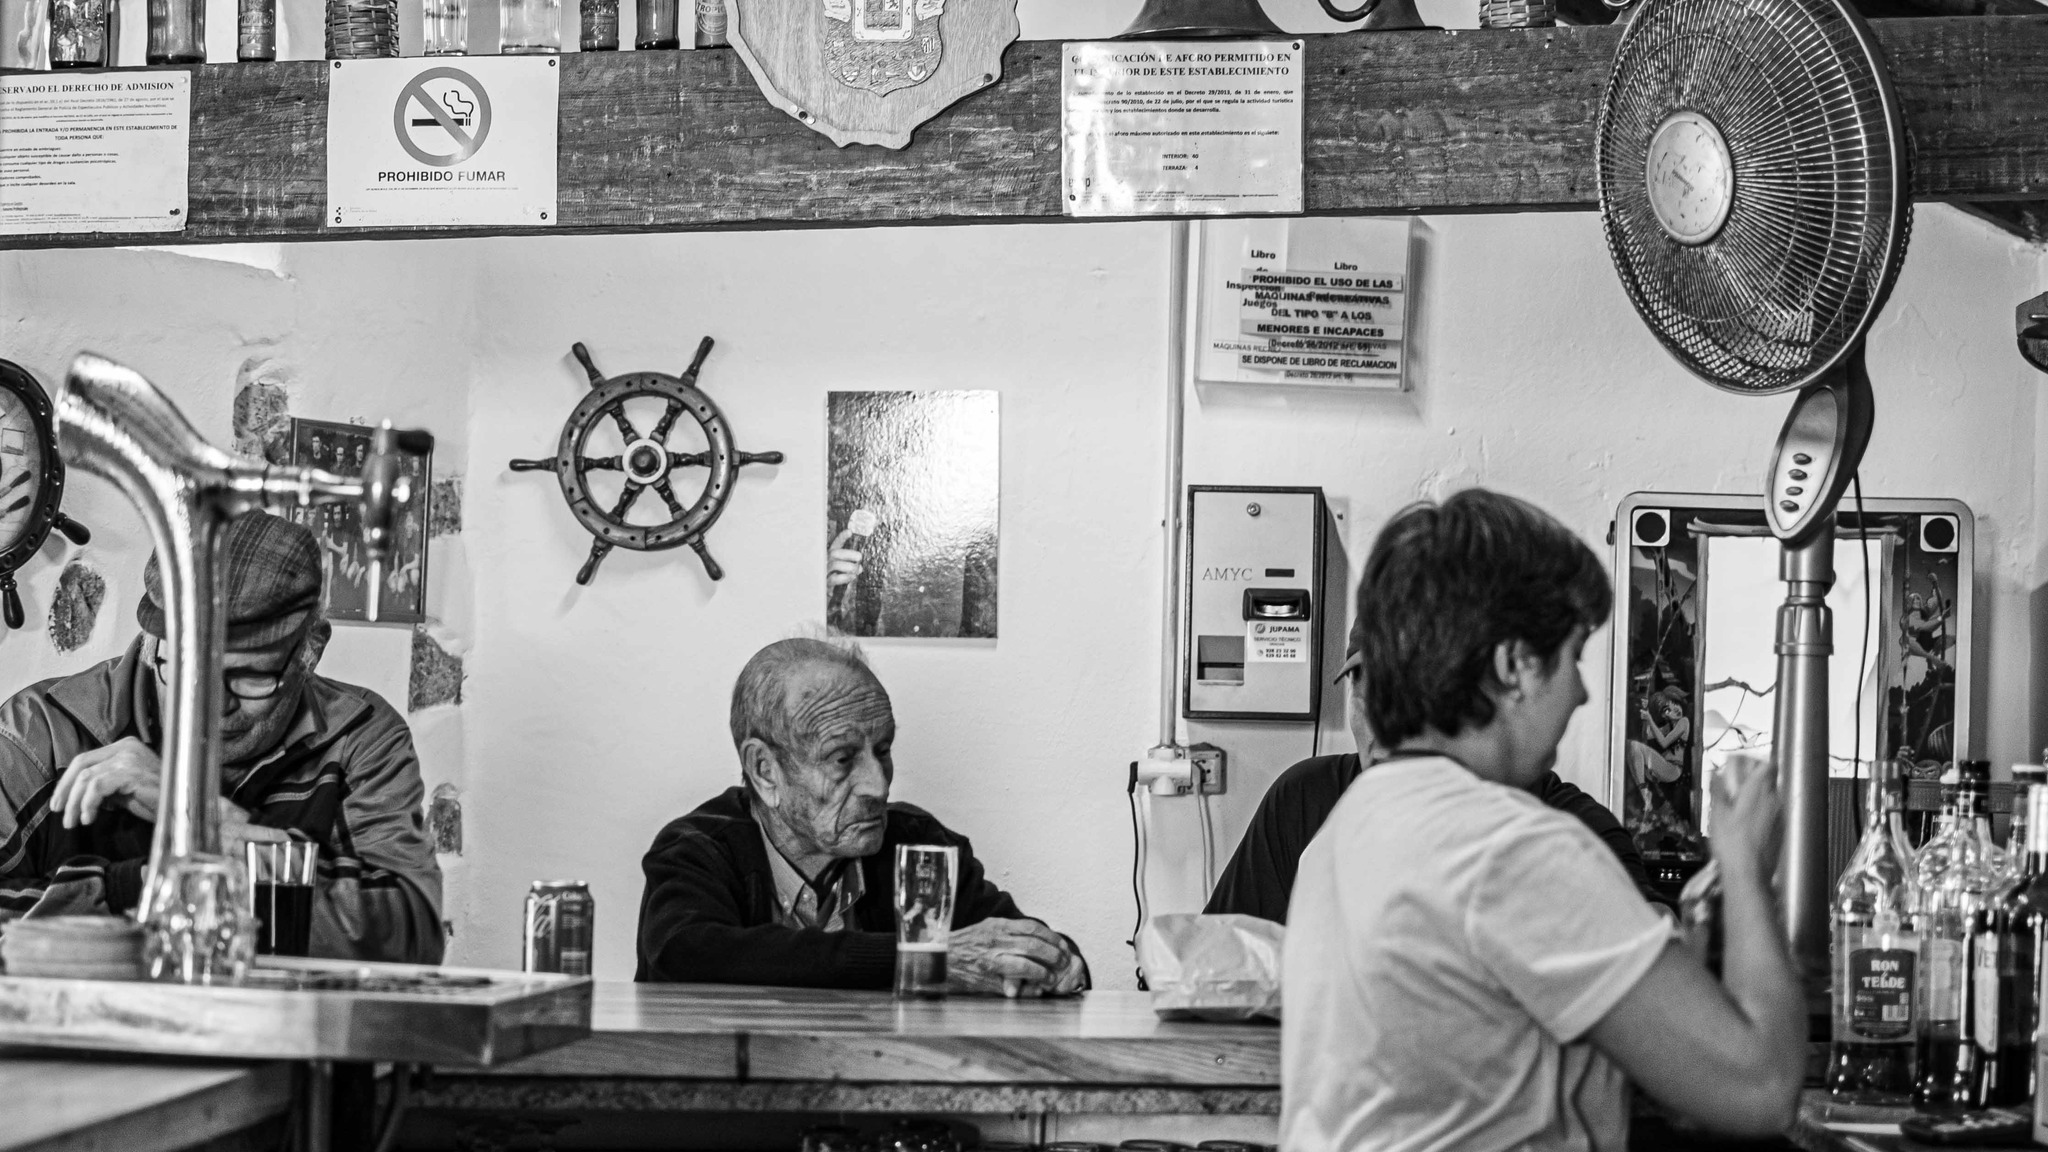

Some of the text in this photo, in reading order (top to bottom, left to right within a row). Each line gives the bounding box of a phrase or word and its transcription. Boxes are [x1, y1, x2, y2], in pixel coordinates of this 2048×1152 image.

[1174, 54, 1212, 62] AFORO
[1214, 54, 1274, 62] PERMITIDO
[1277, 54, 1291, 62] EN
[1144, 68, 1158, 76] DE
[1160, 68, 1186, 76] ESTE
[1188, 67, 1289, 76] ESTABLECIMIENTO
[62, 84, 108, 92] DERECHO
[126, 82, 174, 90] ADMISION
[378, 171, 506, 182] PROHIBIDO FUMAR
[1251, 250, 1276, 259] Libro
[1334, 262, 1358, 271] Libro
[1252, 275, 1393, 288] PROHIBIDO EL USO DE LAS
[1255, 292, 1312, 302] MAQUINAS
[1242, 298, 1278, 309] Juegos
[1271, 308, 1372, 320] DEL TIPO "B" A LOS
[1257, 324, 1384, 337] MENORES E INCAPACES
[1242, 355, 1397, 370] SE DISPONE DE LIBRO DE RECLAMACION
[1202, 567, 1253, 580] AMYC
[1870, 960, 1899, 972] RON
[1862, 976, 1906, 989] TELDE
